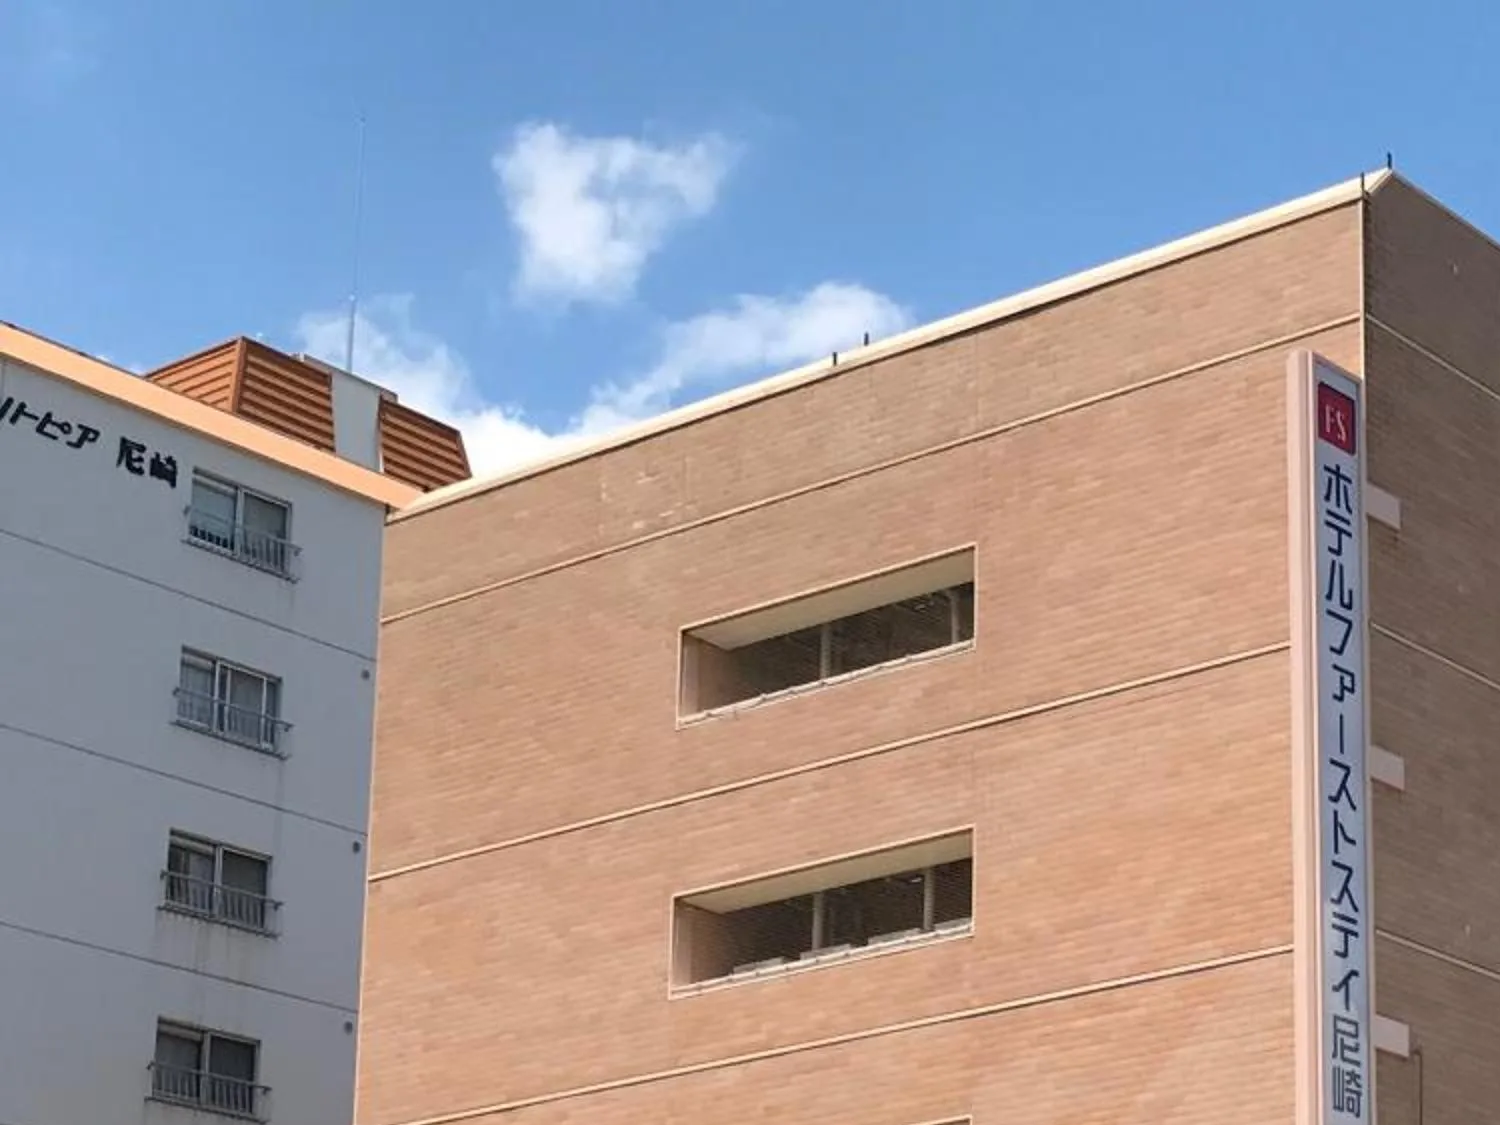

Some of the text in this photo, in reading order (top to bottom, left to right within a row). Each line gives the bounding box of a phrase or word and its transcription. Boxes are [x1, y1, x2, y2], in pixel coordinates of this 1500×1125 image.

[1325, 404, 1347, 442] FS
[116, 436, 178, 489] 尼崎
[1323, 463, 1362, 1119] ホテルファーストステイ尼崎
